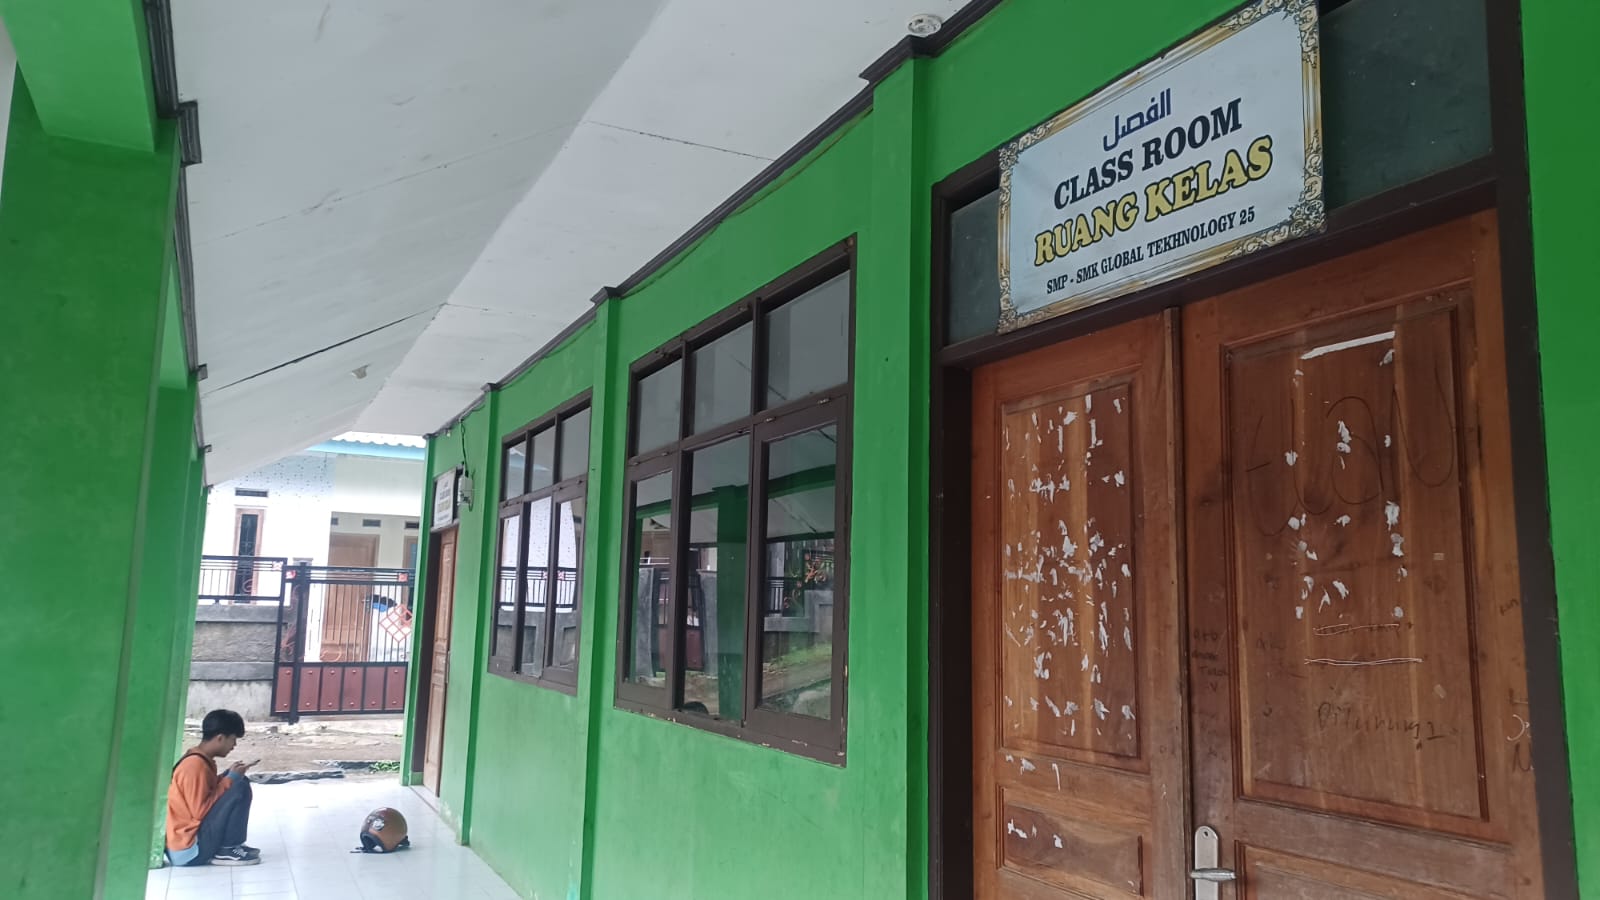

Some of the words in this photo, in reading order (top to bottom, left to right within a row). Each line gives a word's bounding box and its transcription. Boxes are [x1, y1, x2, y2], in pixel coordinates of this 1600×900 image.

[1054, 149, 1134, 209] CLASS
[1142, 98, 1242, 171] ROOM
[1103, 88, 1171, 152] الفصل
[1034, 193, 1139, 266] RUANG
[1144, 135, 1273, 222] KELAS
[1046, 274, 1068, 294] SMP
[1076, 262, 1099, 284] SMK
[1101, 247, 1144, 275] GLOBAL
[1147, 211, 1237, 258] TEKHNOLOGY
[1239, 206, 1255, 226] 25
